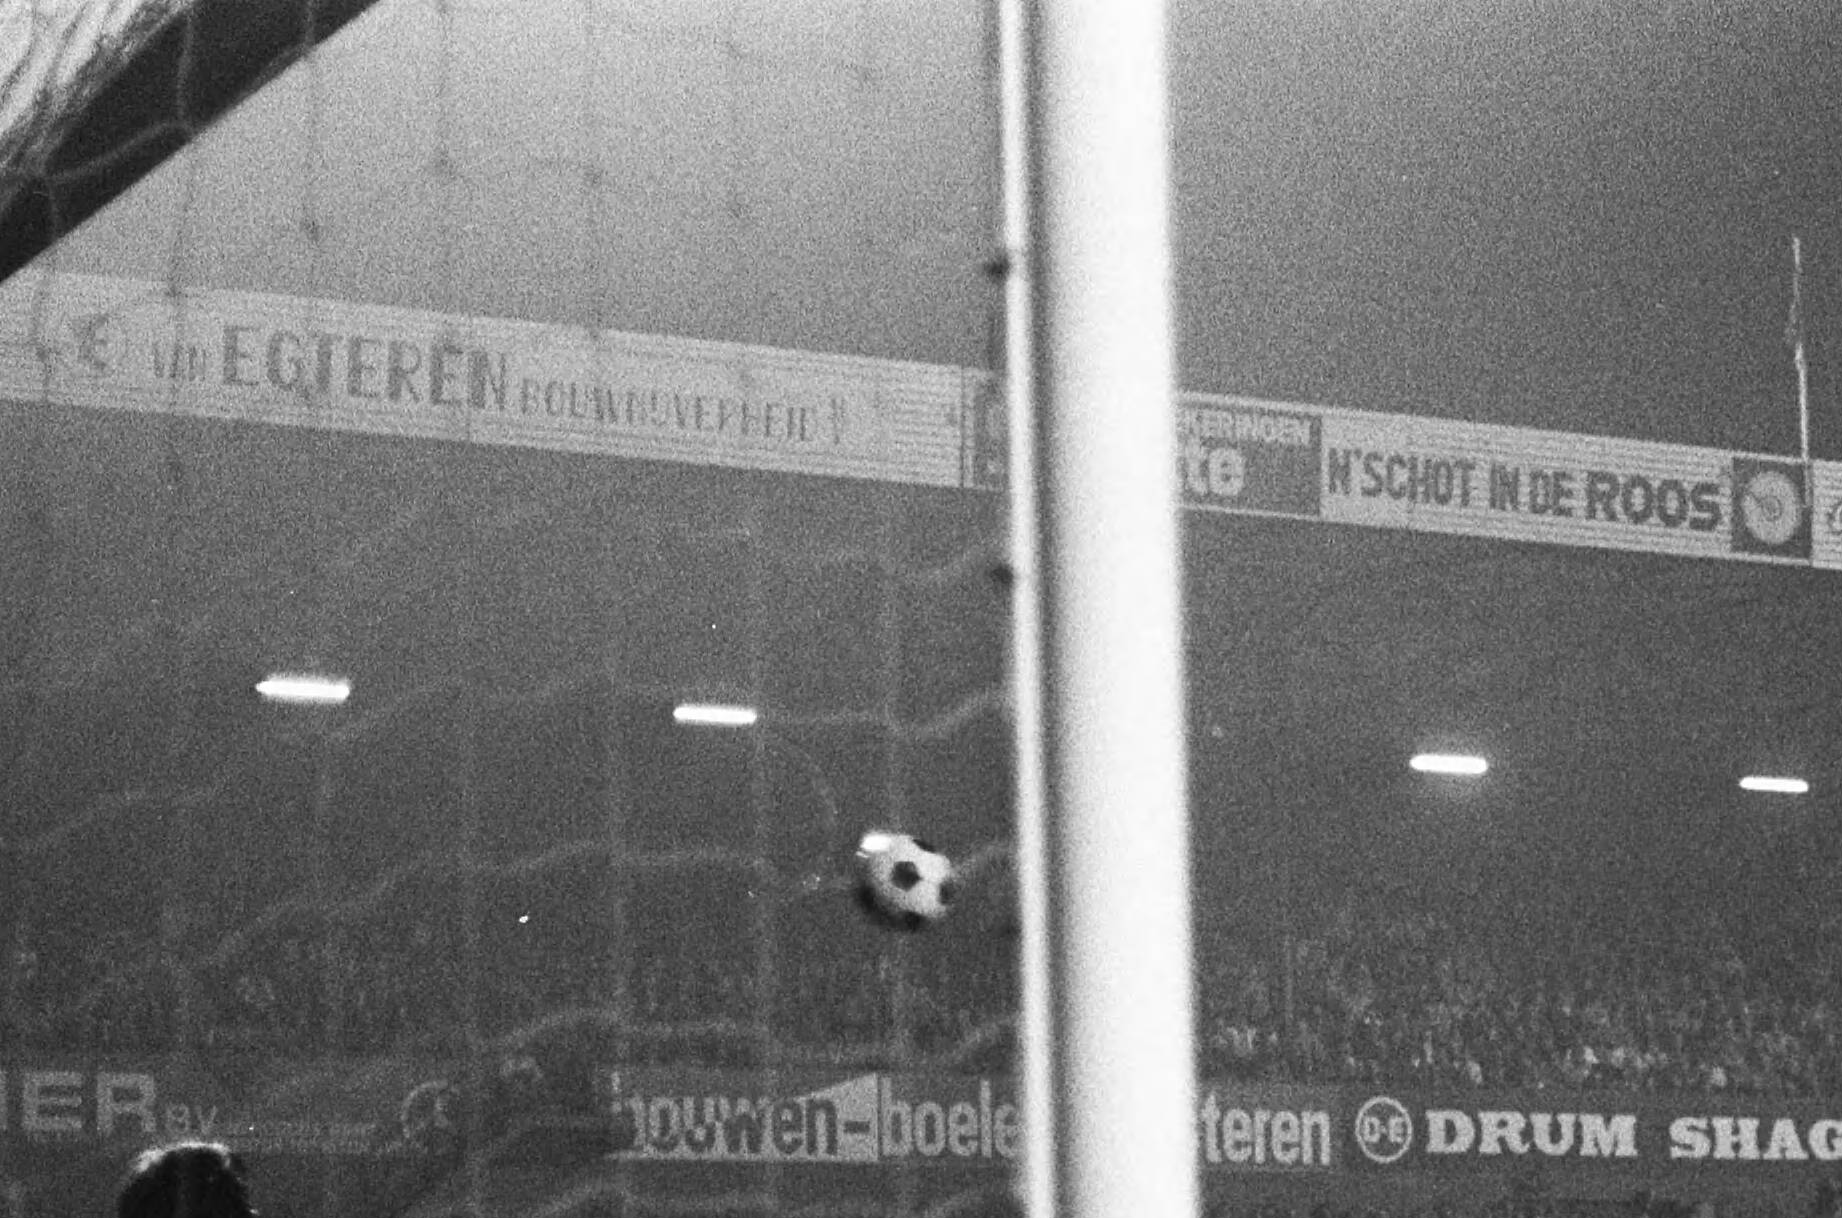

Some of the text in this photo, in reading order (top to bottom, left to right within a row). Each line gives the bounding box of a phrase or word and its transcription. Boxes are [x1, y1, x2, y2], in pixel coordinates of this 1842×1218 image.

[223, 325, 506, 409] EGTEREN
[1489, 463, 1520, 512] IN
[1529, 469, 1575, 518] DE
[1584, 470, 1723, 532] ROOS
[0, 1069, 156, 1135] ER
[1425, 1109, 1638, 1157] DRUM
